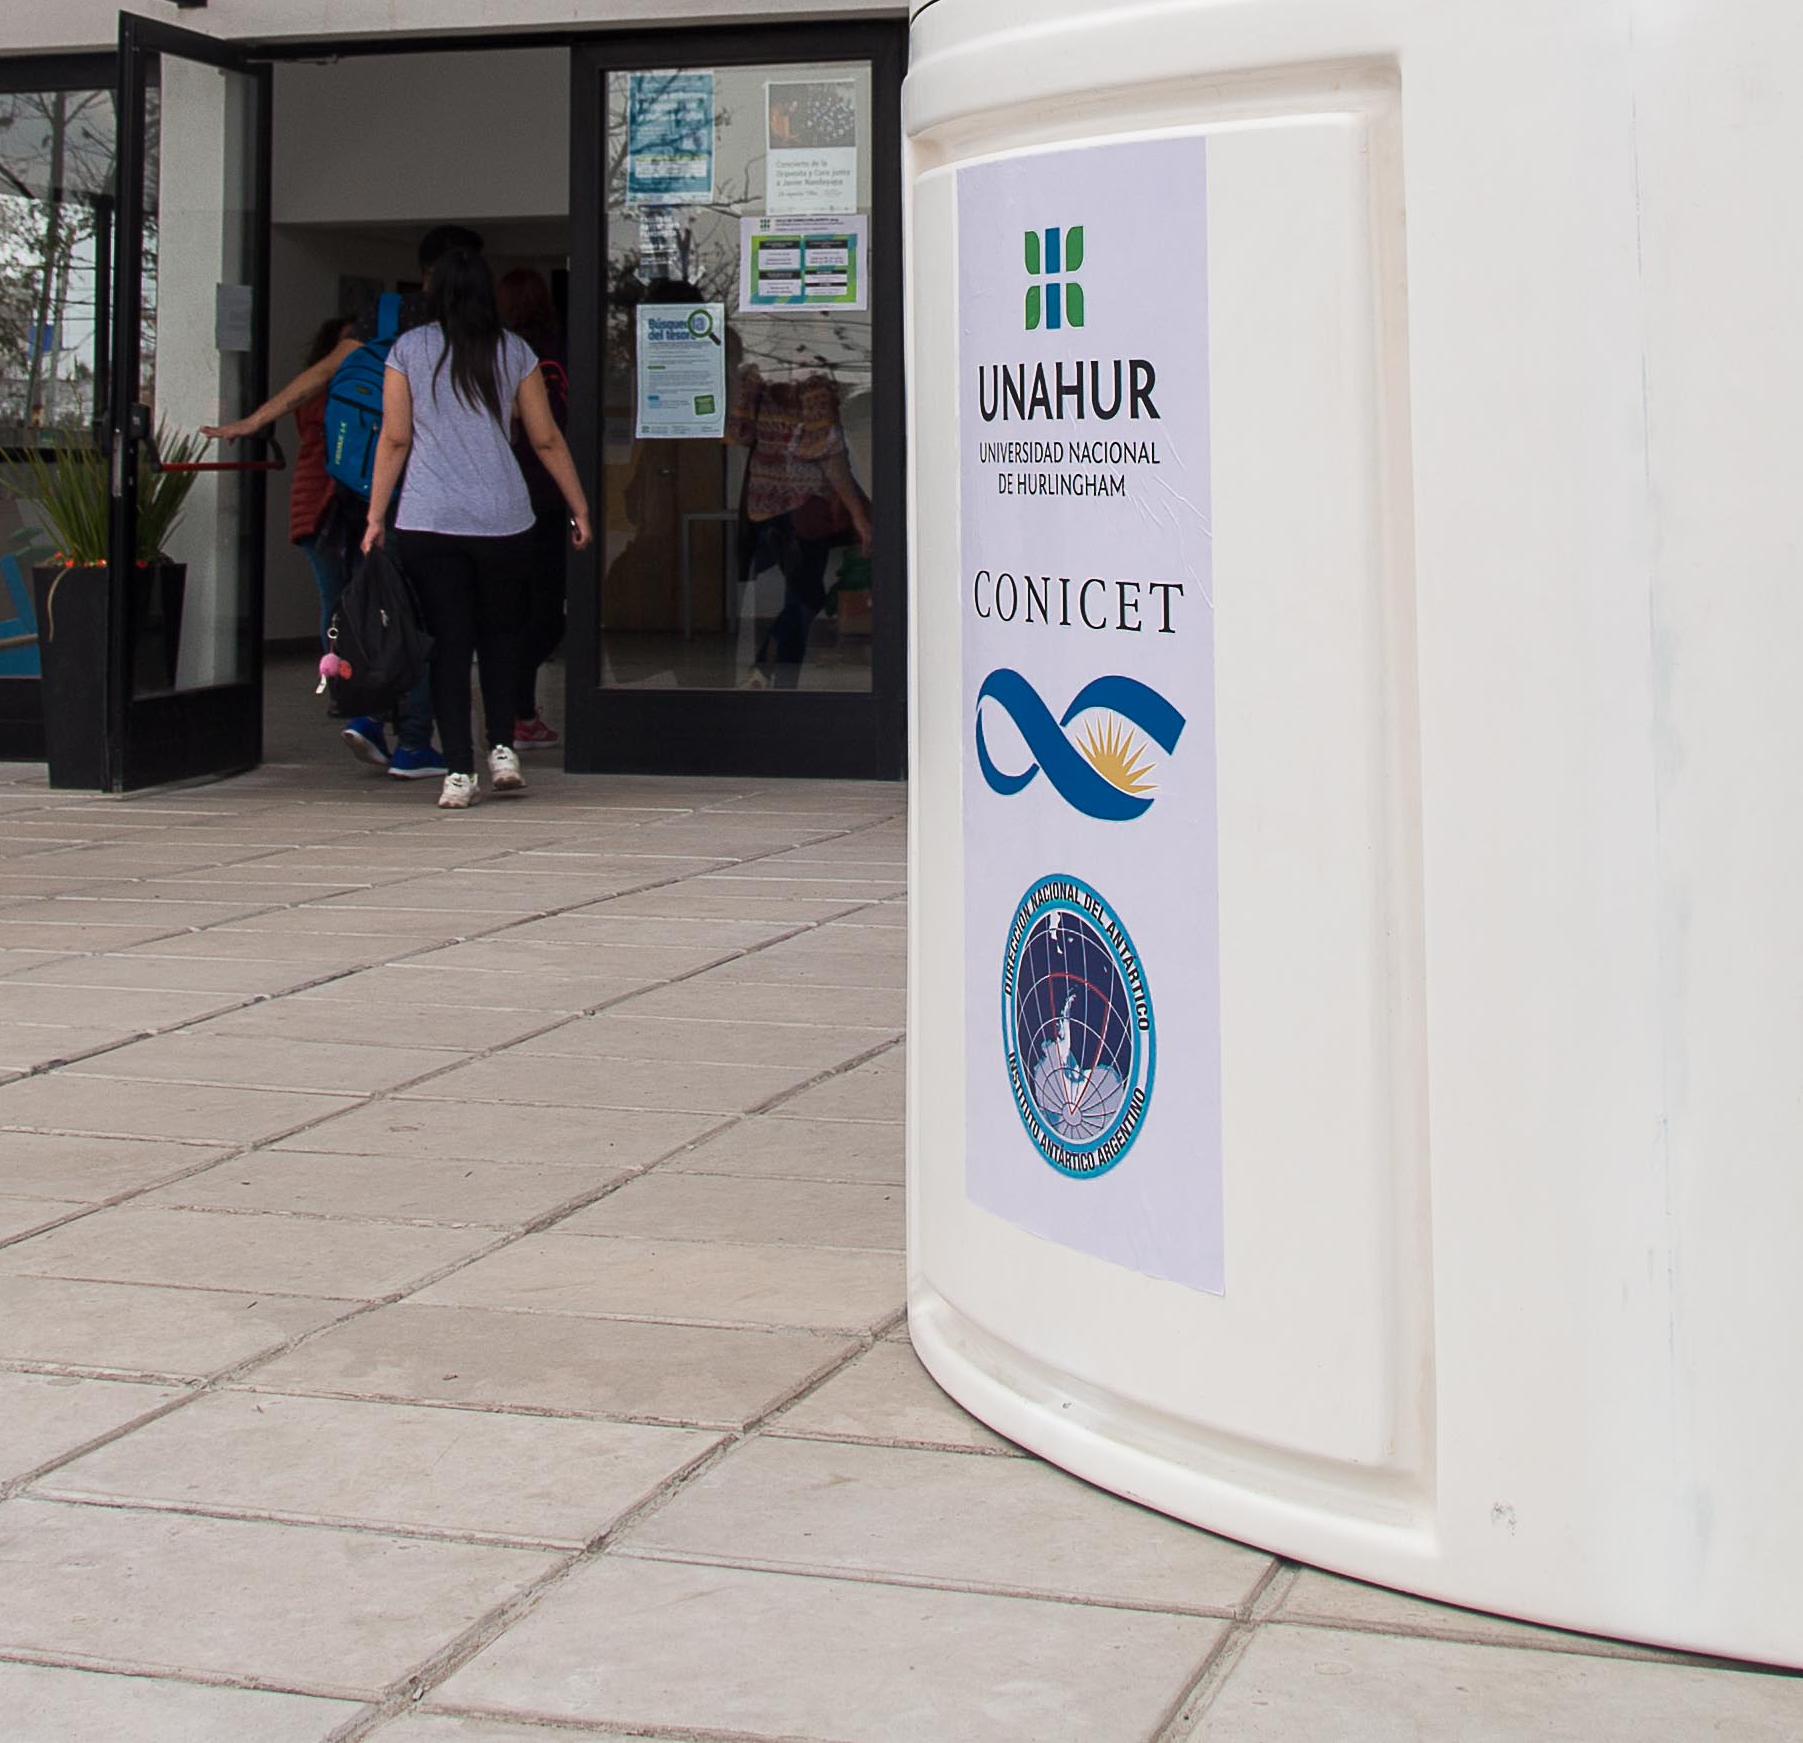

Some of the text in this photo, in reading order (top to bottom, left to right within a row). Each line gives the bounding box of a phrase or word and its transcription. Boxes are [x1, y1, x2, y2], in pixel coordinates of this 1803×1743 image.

[979, 359, 1162, 422] UNAHUR
[979, 441, 1161, 465] UNIVERSIDAD NACIONAL
[998, 473, 1126, 497] DE HURLINGHAM
[974, 570, 1185, 634] CONICET
[1029, 881, 1082, 913] NACIONAL
[1083, 891, 1109, 926] DEL
[1105, 921, 1151, 1032] ANTÁRTICO
[1008, 1051, 1148, 1173] INSTITUTO ANTÁRTICO ARGENTINO
